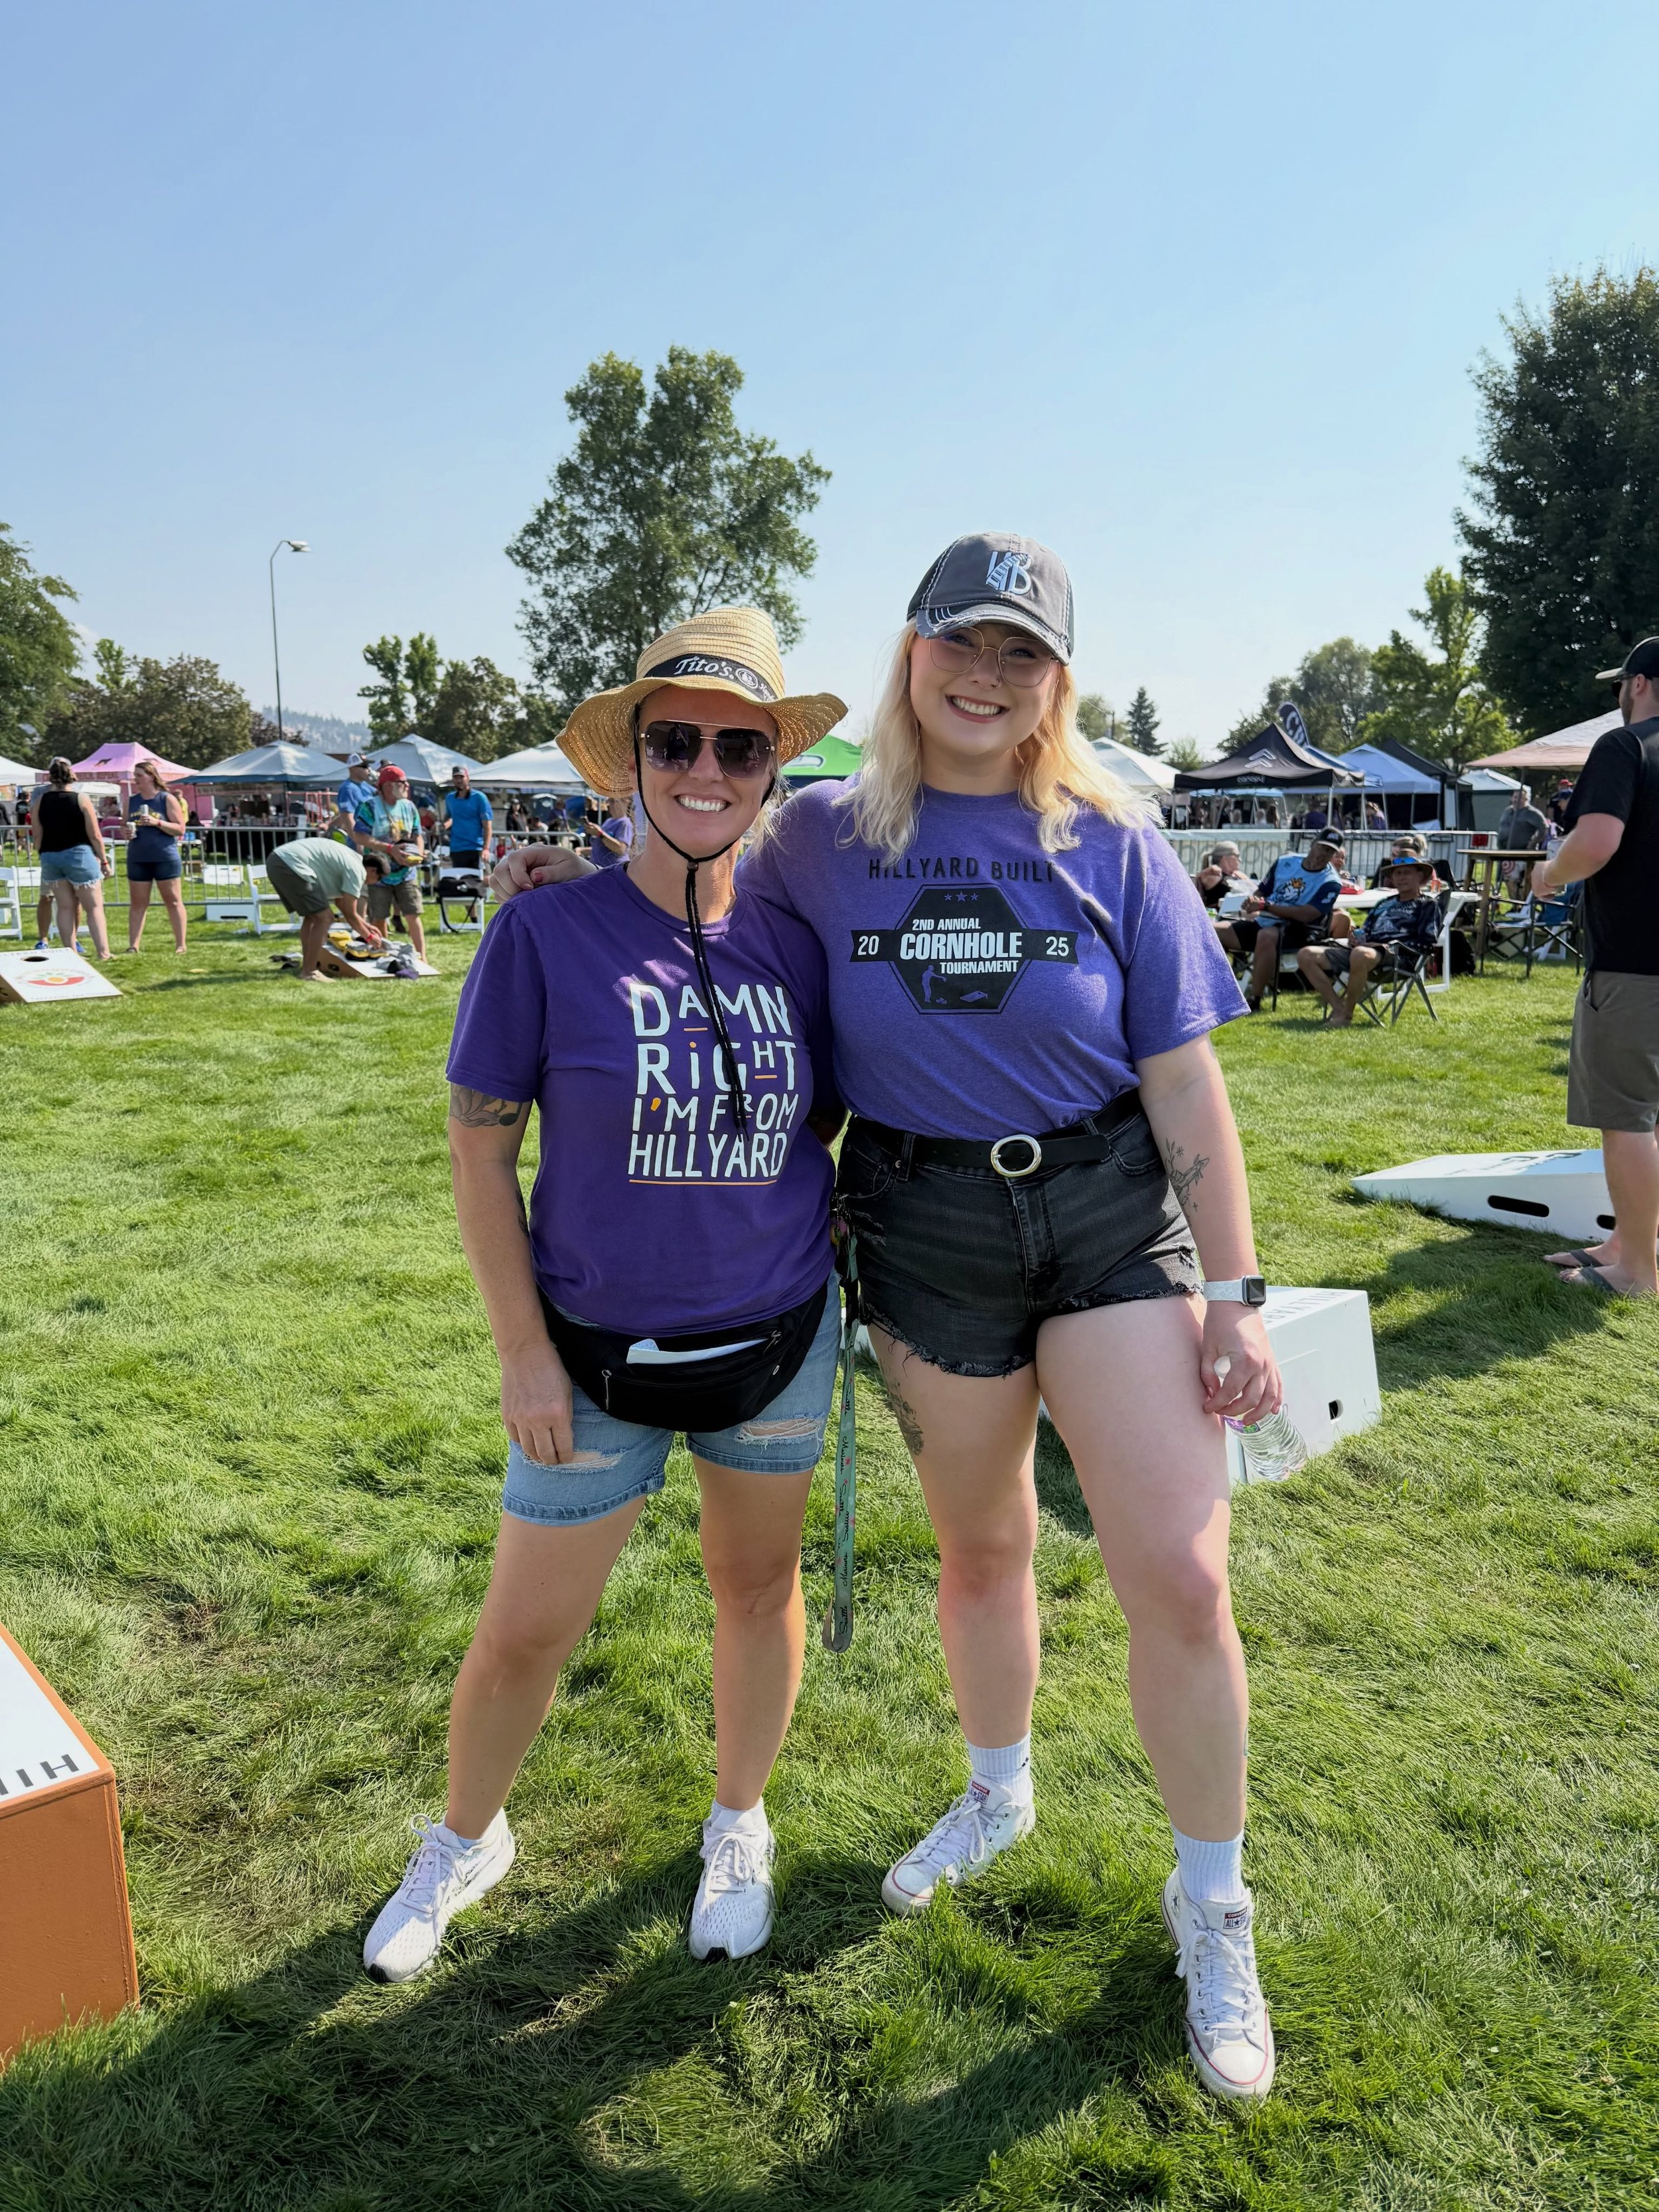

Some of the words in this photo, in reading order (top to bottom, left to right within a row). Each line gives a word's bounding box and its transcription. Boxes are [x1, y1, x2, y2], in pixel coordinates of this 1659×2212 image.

[869, 856, 979, 879] HILLYARD
[991, 860, 1052, 882] BUILT
[912, 919, 934, 930] 2ND
[937, 918, 981, 930] ANNUAL
[857, 935, 880, 956] 20
[900, 932, 1023, 960] CORNHOLE
[1045, 936, 1069, 956] 25
[940, 960, 1019, 974] TOURNAMENT
[630, 984, 794, 1037] DAMN
[632, 1096, 699, 1132] I'M
[628, 1132, 788, 1178] HILLYARD
[1263, 1291, 1348, 1324] HILLYAR
[1225, 1919, 1234, 1928] ALL
